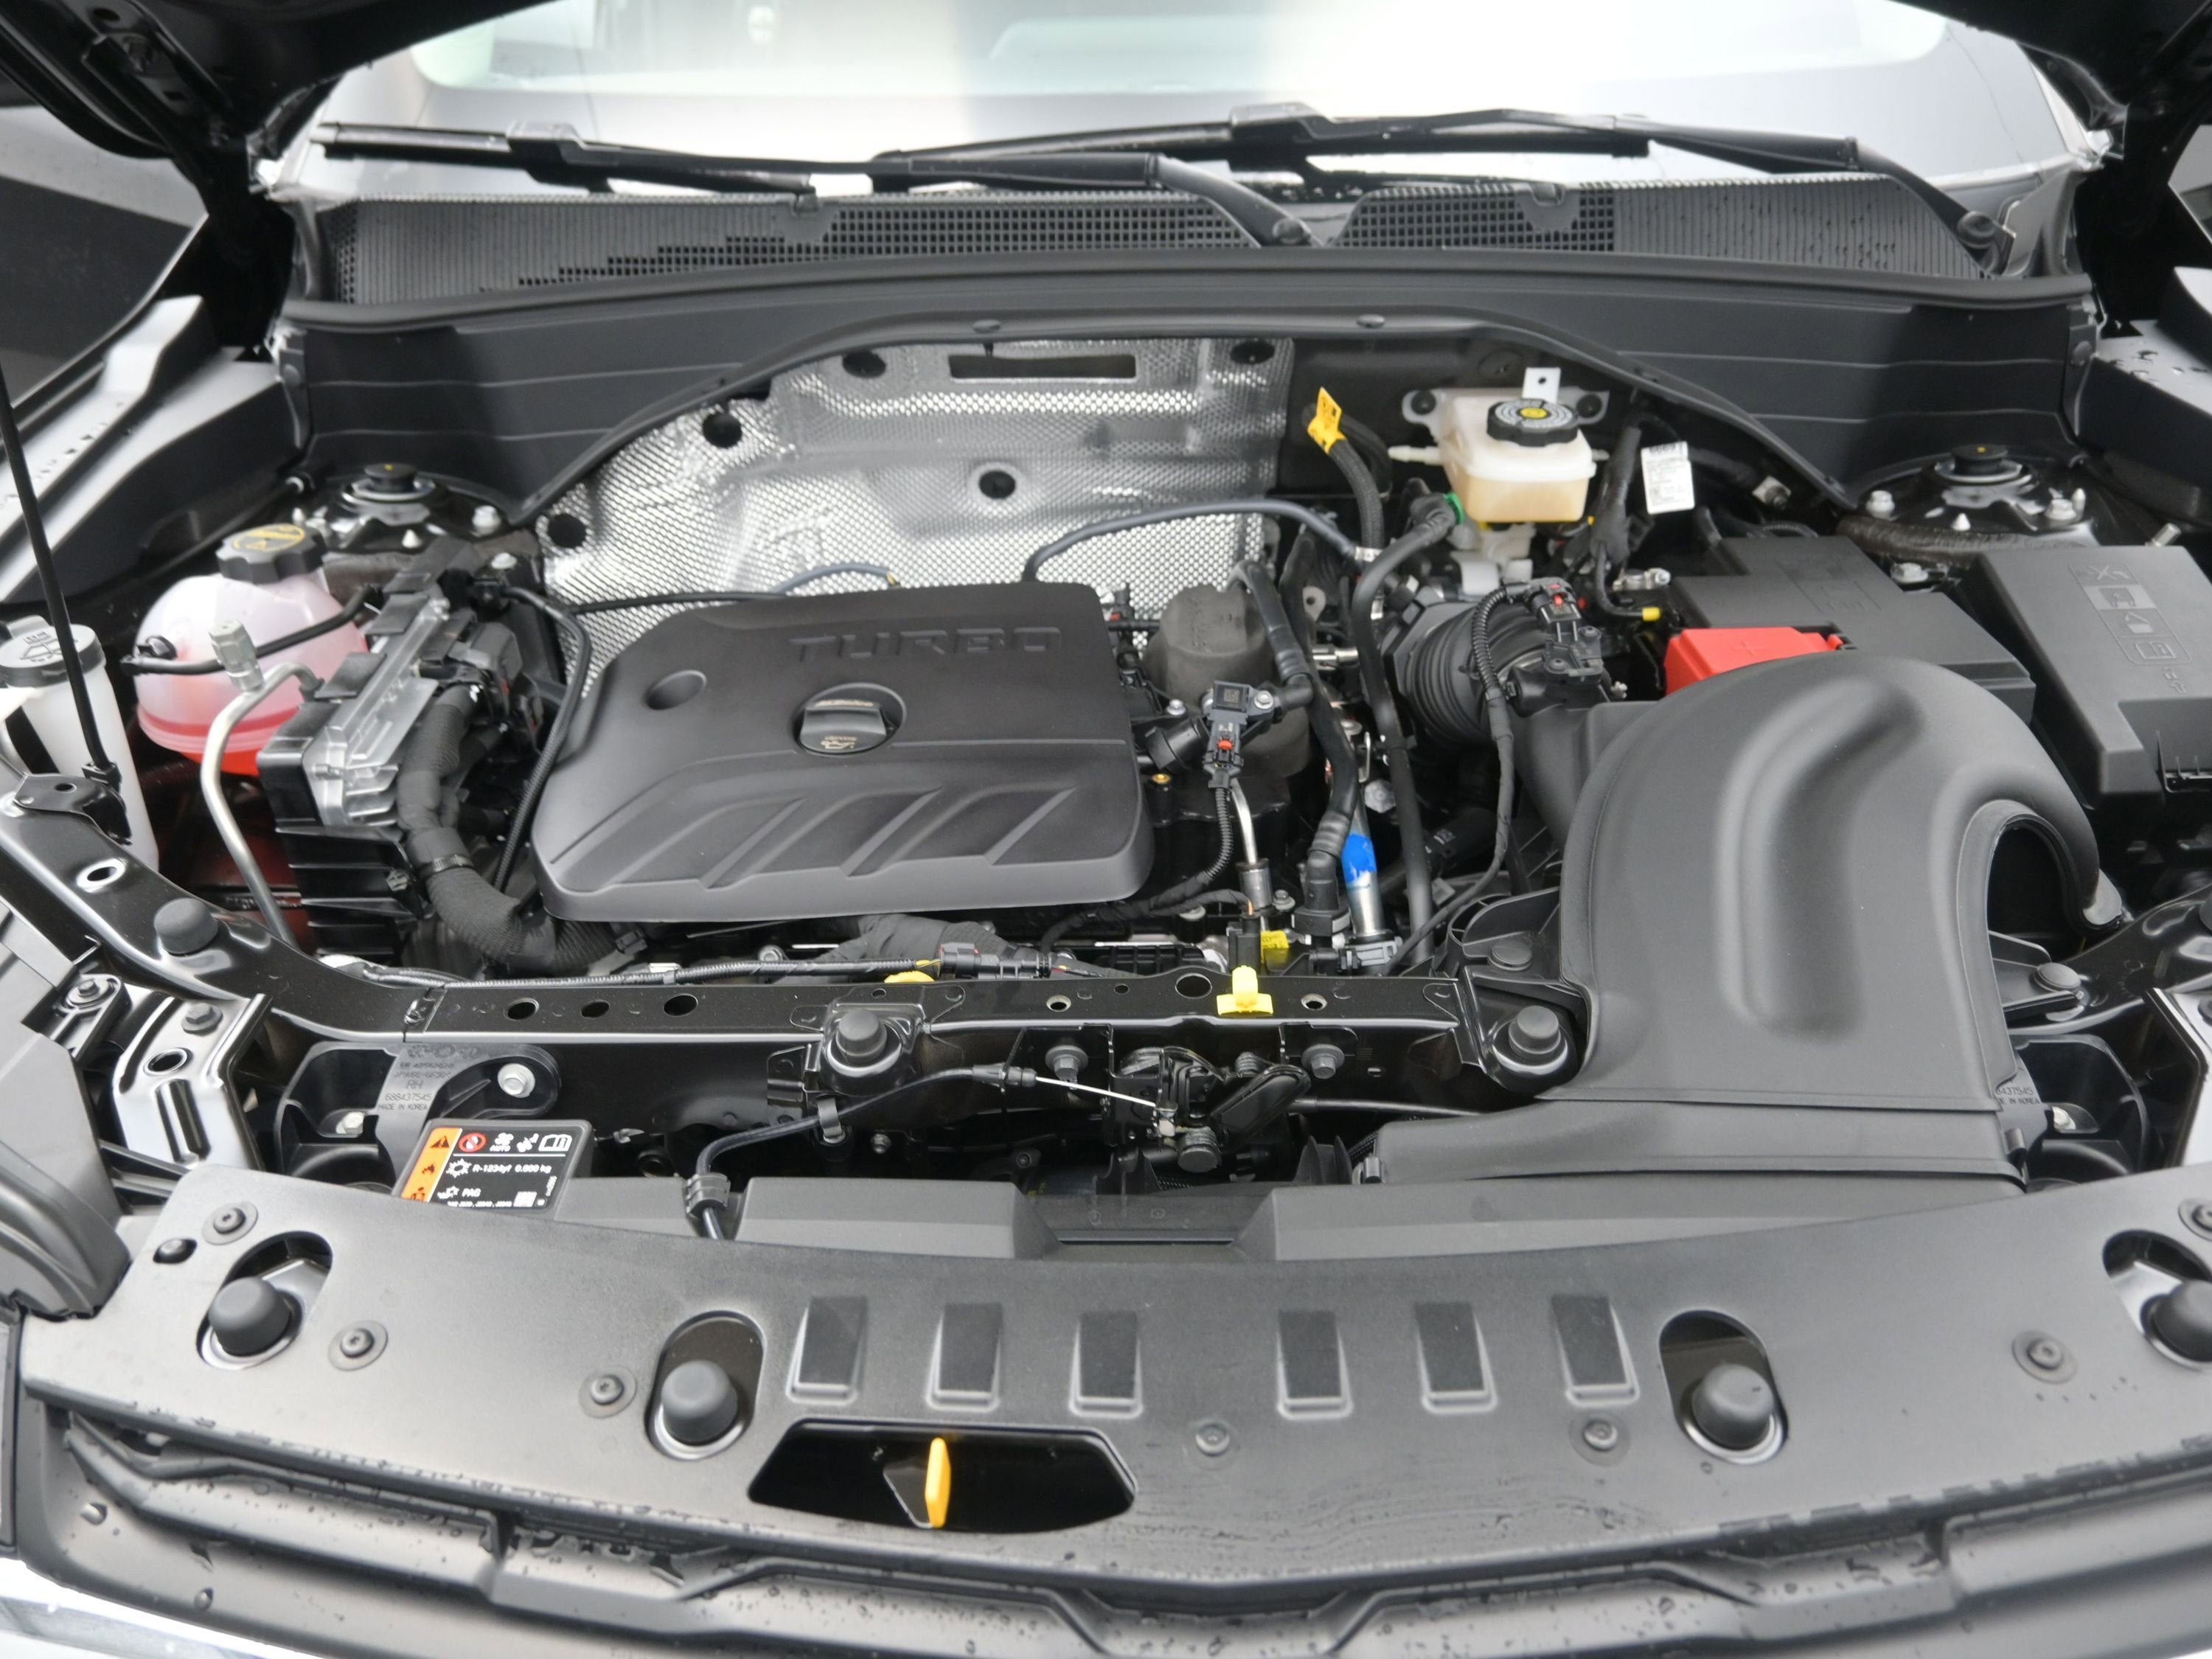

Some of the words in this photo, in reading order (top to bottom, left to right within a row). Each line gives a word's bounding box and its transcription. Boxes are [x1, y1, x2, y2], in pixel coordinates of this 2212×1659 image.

[787, 625, 1062, 663] TURBO
[405, 1079, 424, 1090] RH
[473, 1164, 512, 1174] R-1234yf
[540, 1164, 552, 1174] kg
[462, 1188, 481, 1197] PAG
